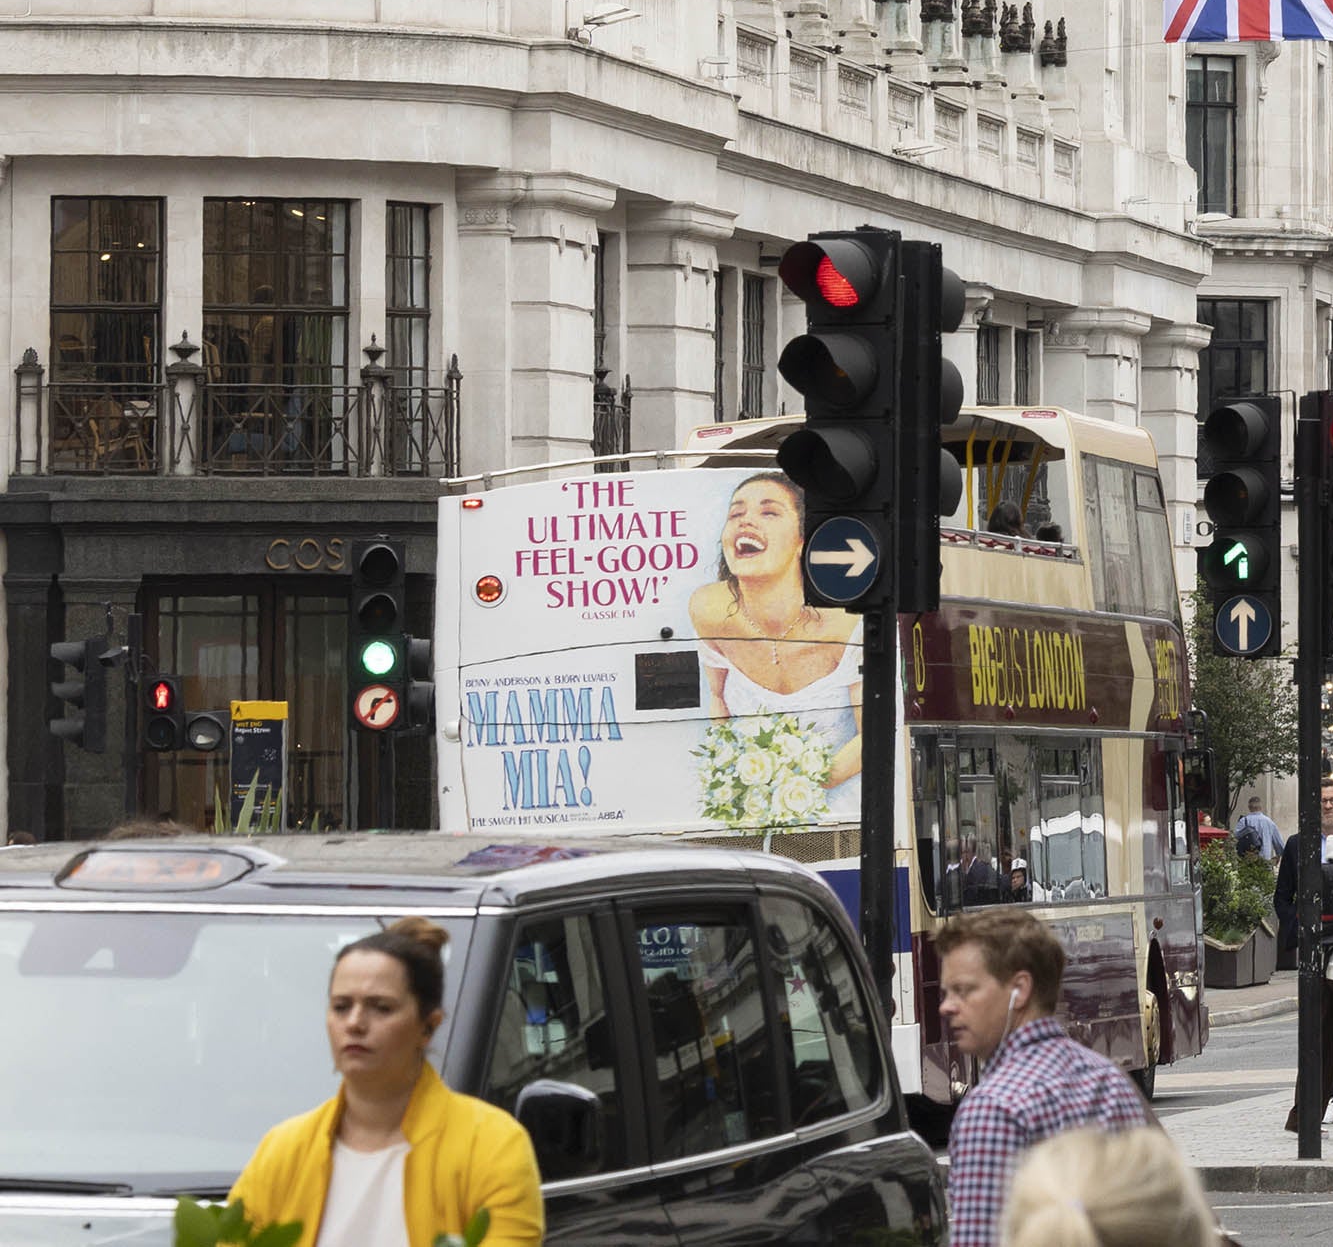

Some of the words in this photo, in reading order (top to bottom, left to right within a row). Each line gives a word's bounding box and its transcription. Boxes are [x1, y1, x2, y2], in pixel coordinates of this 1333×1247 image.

[528, 510, 688, 545] ULTIMATE
[266, 538, 345, 571] COS
[515, 542, 700, 578] FEEL-GOOD
[581, 611, 620, 621] CLASSIC
[622, 610, 636, 620] FM
[1024, 628, 1087, 711] LONDON
[466, 686, 623, 748] MAMMA
[501, 745, 593, 811] MIA!
